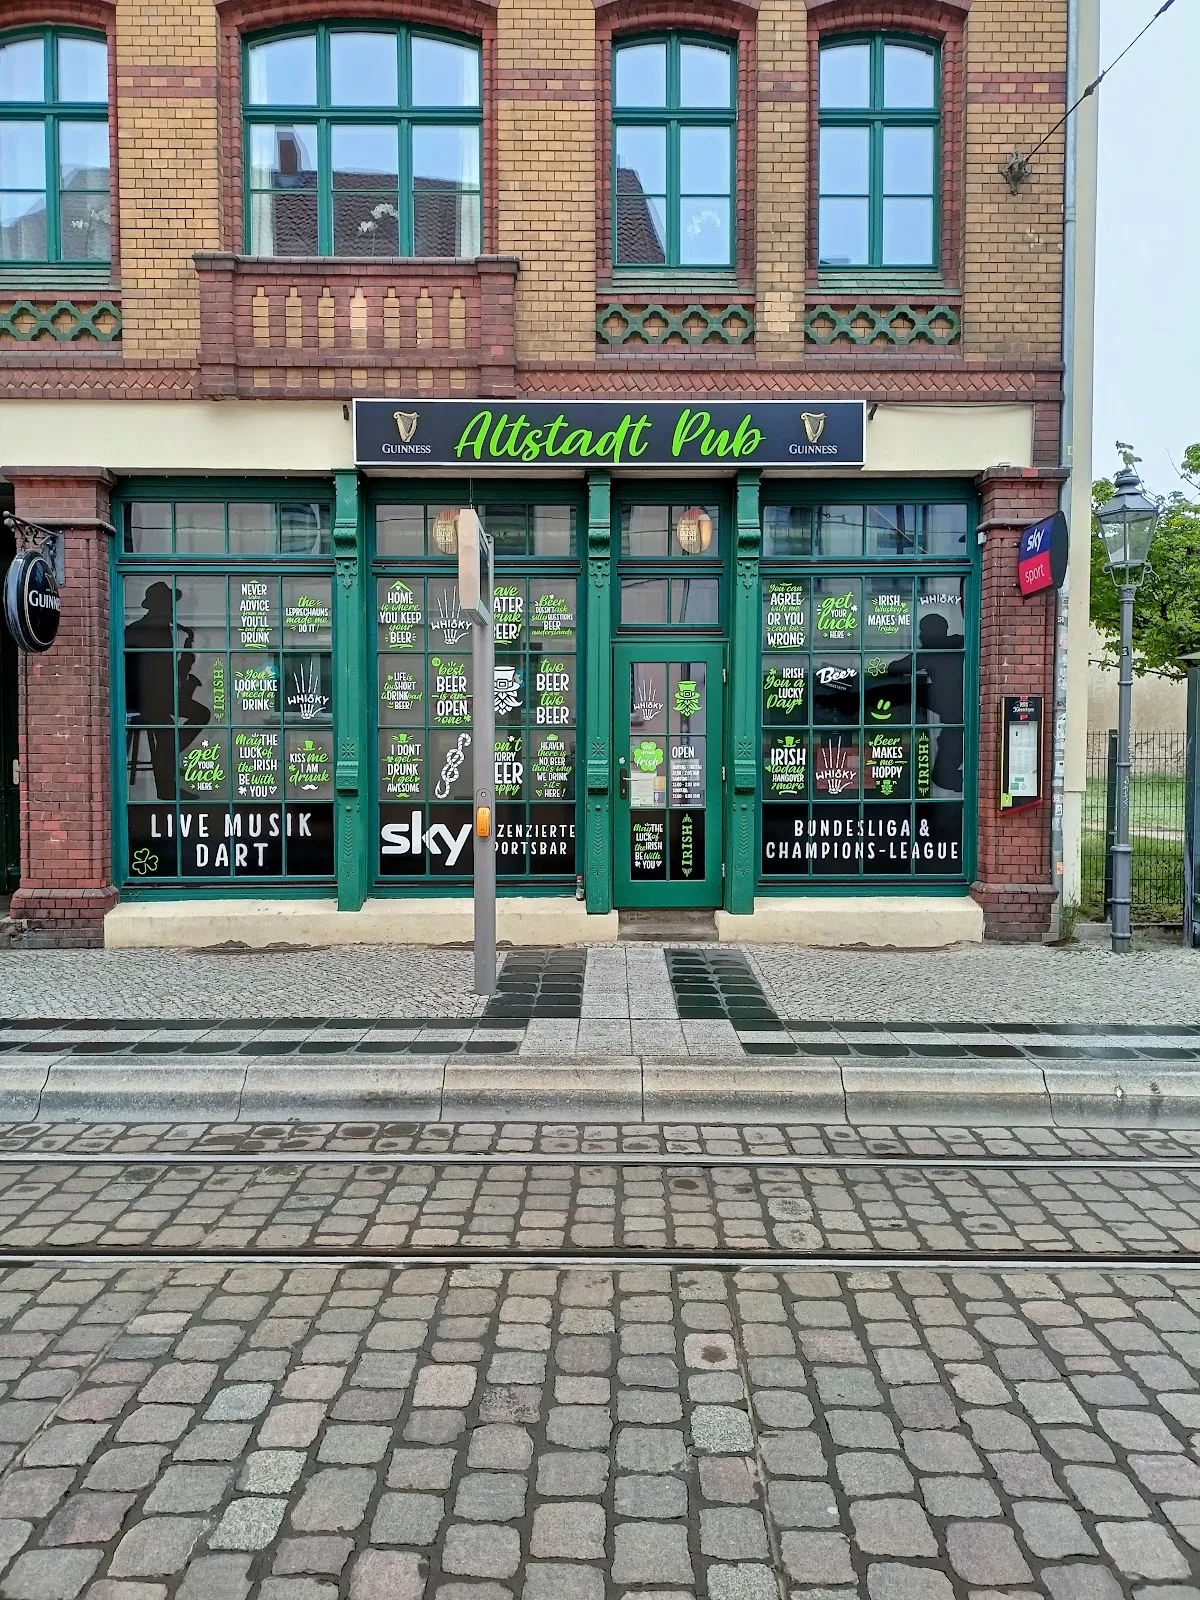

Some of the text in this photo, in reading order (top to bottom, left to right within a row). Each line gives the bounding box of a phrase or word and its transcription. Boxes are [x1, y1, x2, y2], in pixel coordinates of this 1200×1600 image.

[453, 408, 766, 463] Altstadt Pub
[382, 443, 431, 454] GUINNESS
[789, 443, 838, 455] GUINNESS
[1026, 528, 1045, 552] sky
[1024, 564, 1045, 585] sport
[241, 584, 268, 596] NEVER
[493, 585, 519, 596] ave
[29, 590, 61, 612] GUINNE
[298, 596, 317, 608] the
[387, 591, 414, 604] HOME
[539, 594, 566, 607] Beer
[770, 592, 803, 606] AGREE
[820, 591, 855, 613] get
[878, 594, 901, 606] IRISH
[919, 593, 962, 606] WHISKY
[240, 600, 270, 612] ADVICE
[381, 602, 420, 612] is where
[493, 596, 524, 613] ATER
[285, 607, 329, 617] LEPRECHAUNS
[380, 611, 422, 624] YOU KEEP
[493, 609, 523, 623] rink
[830, 608, 848, 618] YOUR
[286, 615, 313, 626] made
[431, 619, 473, 631] WHISKY
[767, 612, 804, 626] OR YOU
[817, 609, 859, 631] luck
[867, 614, 911, 626] MAKES ME
[298, 624, 307, 633] DO
[389, 623, 414, 633] your
[543, 620, 561, 631] BEER
[241, 632, 271, 643] DRUNK
[389, 631, 412, 644] BEER
[767, 632, 805, 646] WRONG
[829, 630, 845, 639] HERE
[438, 662, 466, 676] best
[540, 658, 566, 673] two
[394, 671, 414, 681] LIFE is
[782, 668, 804, 679] IRISH
[816, 666, 858, 684] Beer
[234, 680, 278, 691] LOOK LIKE
[394, 681, 417, 691] SHORT
[436, 675, 467, 693] BEER
[536, 673, 570, 692] BEER
[793, 678, 806, 688] a
[213, 669, 224, 711] IRISH
[387, 690, 409, 701] DRINK
[439, 690, 448, 701] is
[778, 688, 804, 699] LUCKY
[243, 699, 269, 711] DRINK
[287, 694, 330, 706] WHISKY
[540, 691, 566, 707] two
[766, 694, 797, 715] Day
[437, 700, 469, 717] OPEN
[633, 701, 664, 711] WHISKY
[440, 714, 465, 725] one
[536, 706, 570, 725] BEER
[235, 733, 278, 748] May THE
[540, 741, 565, 751] HEAVEN
[874, 734, 901, 747] Beer
[188, 746, 222, 767] get
[239, 745, 274, 759] LUCK of
[289, 752, 329, 764] KISS me
[671, 746, 695, 759] OPEN
[770, 747, 807, 766] IRISH
[872, 746, 903, 759] MAKES
[197, 761, 215, 770] YOUR
[394, 754, 412, 765] get
[539, 757, 566, 766] NO BEER
[636, 756, 660, 768] Irish
[918, 743, 930, 787] IRISH
[237, 759, 278, 774] the IRISH
[305, 764, 319, 773] AM
[387, 764, 419, 777] DRUNK
[494, 761, 524, 784] EER
[771, 763, 806, 776] today
[872, 766, 903, 778] HOPPY
[184, 763, 227, 783] luck
[238, 771, 276, 786] BE with
[289, 768, 330, 787] drunk
[536, 772, 568, 781] WE DRINK
[772, 774, 805, 783] HANGOVER
[815, 769, 857, 781] WHISKY
[197, 782, 213, 791] HERE
[249, 786, 268, 798] YOU
[387, 783, 420, 793] AWESOME
[151, 813, 312, 837] LIVE MUSIK
[496, 824, 576, 838] ZENZIERTE
[651, 824, 664, 833] THE
[794, 818, 931, 838] BUNDESLIGA &
[380, 810, 473, 867] sky
[636, 832, 660, 842] LUCK of
[494, 841, 567, 855] PORTSBAR
[634, 841, 663, 852] the IRISH
[681, 825, 693, 866] IRISH
[765, 841, 960, 861] CHAMPIONS-LEAGUE
[196, 843, 269, 867] DART
[635, 851, 644, 861] BE
[642, 859, 656, 869] YOU
